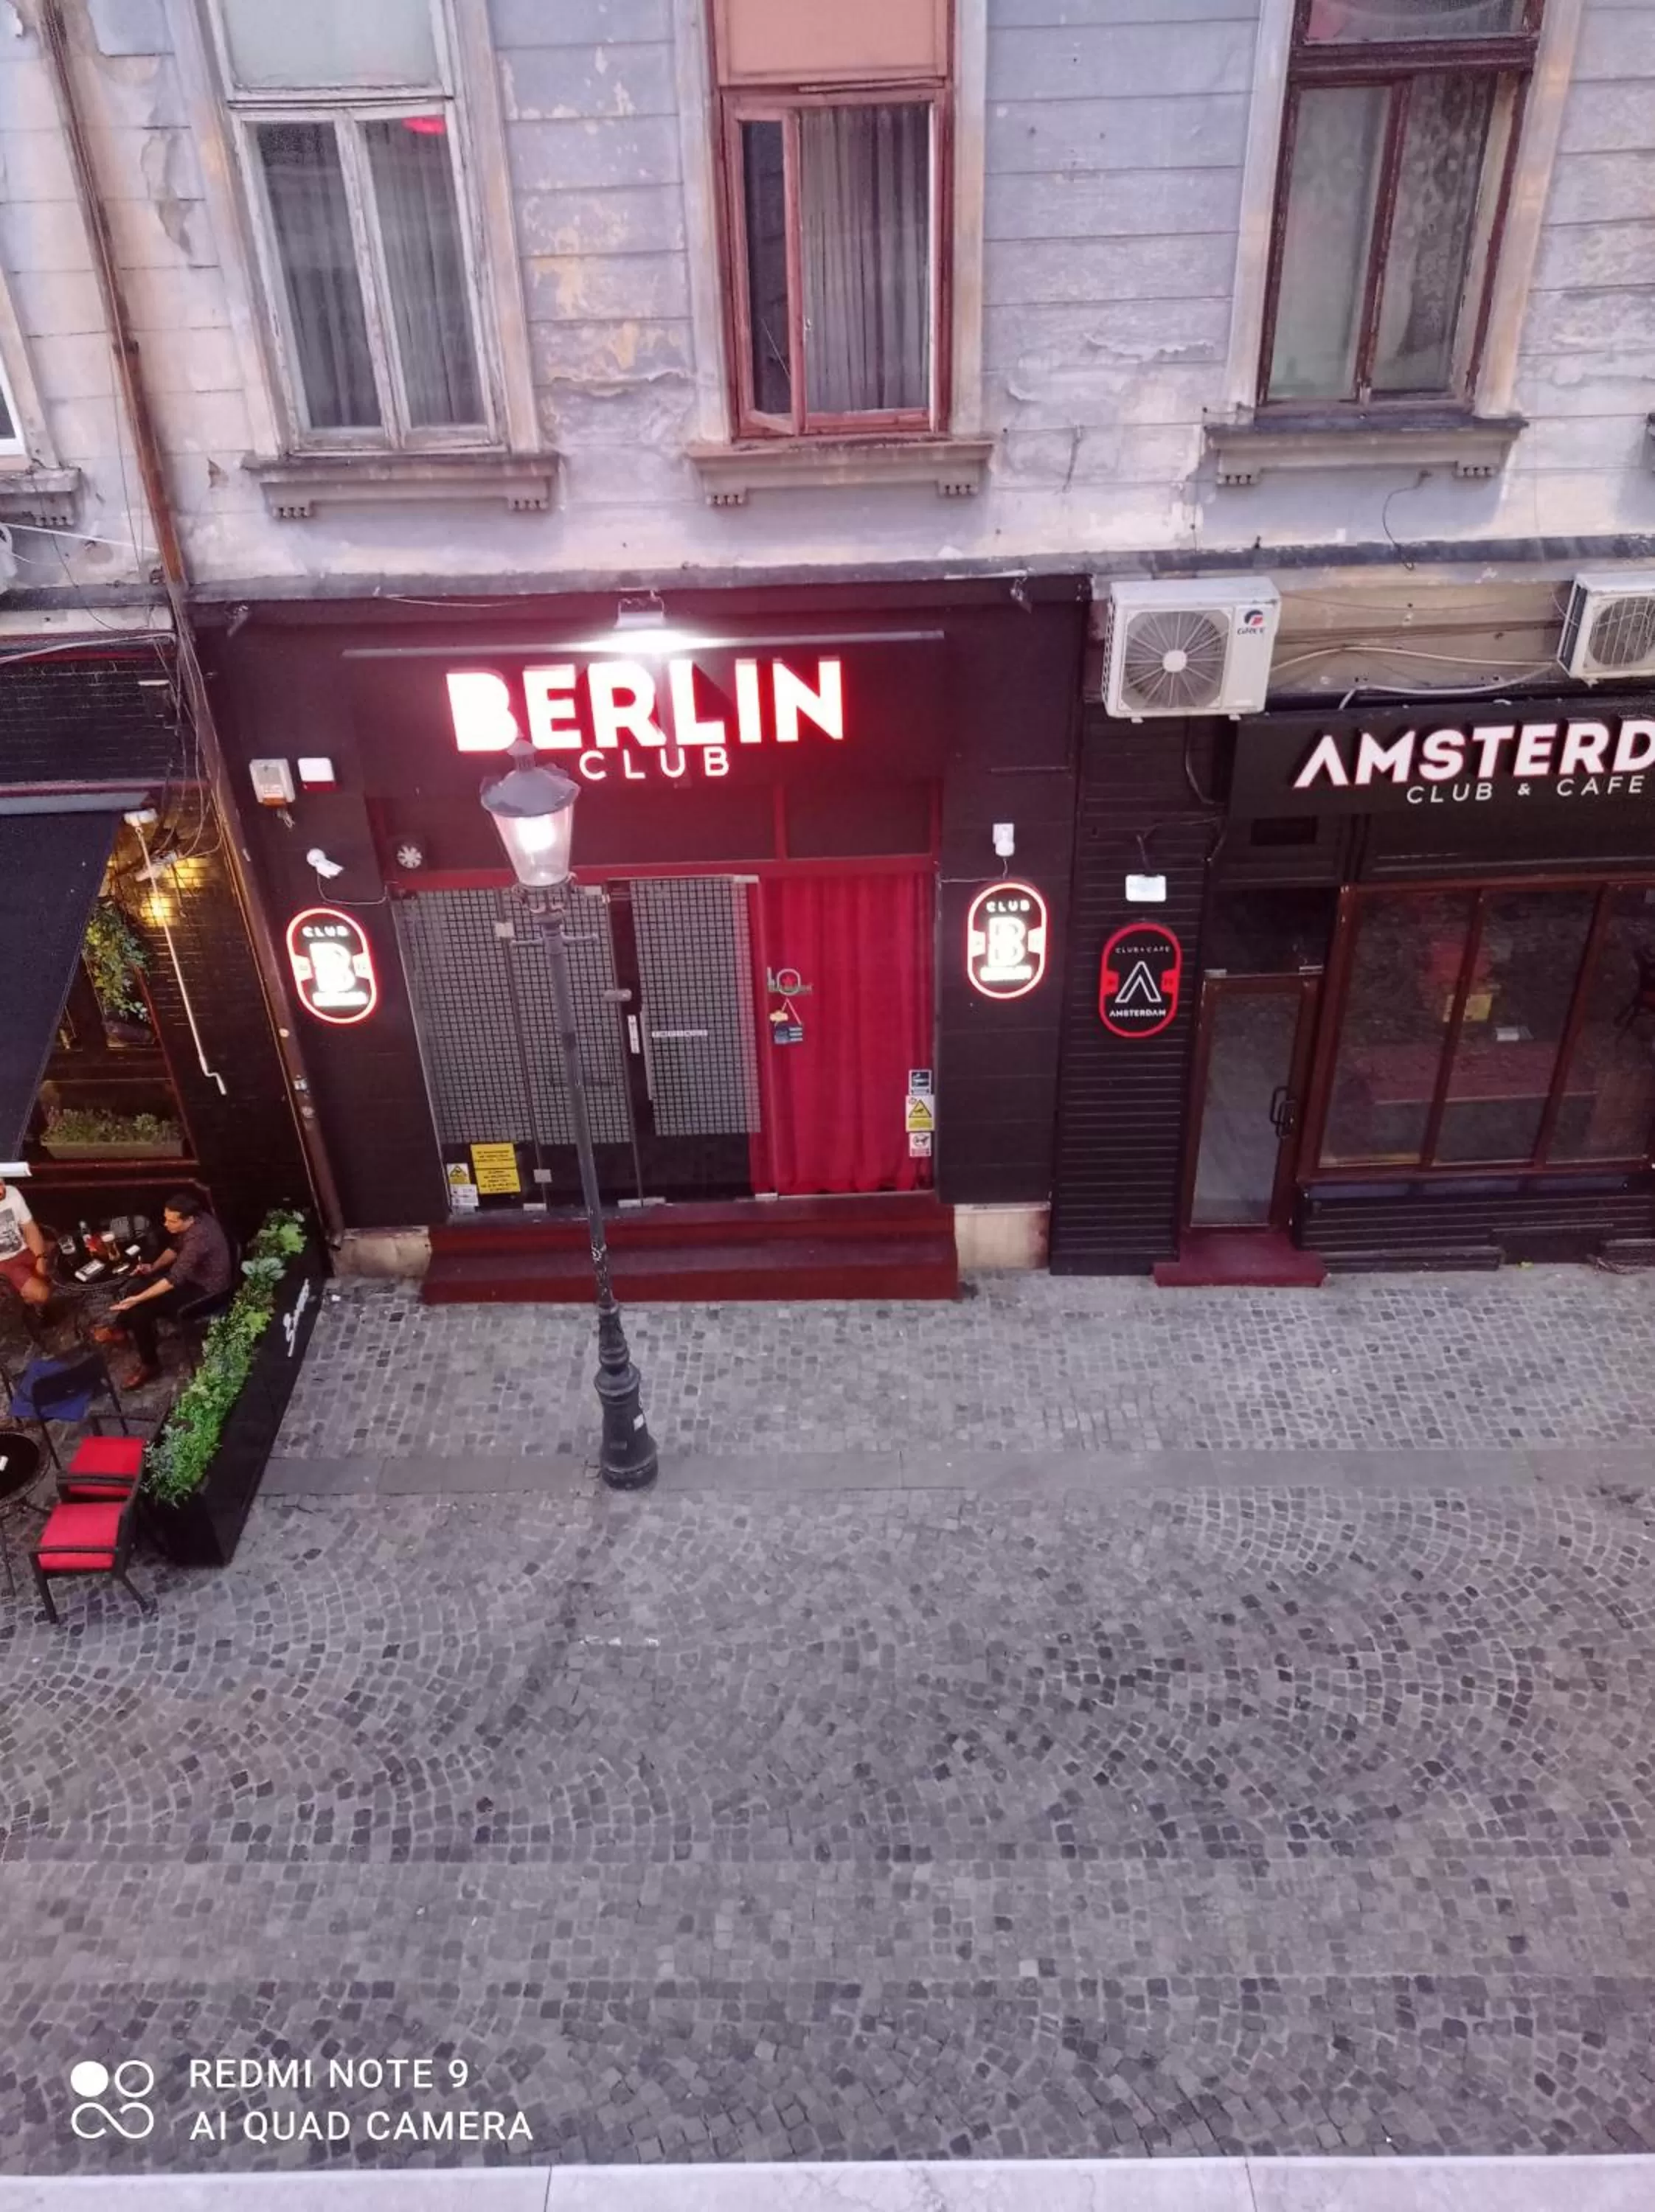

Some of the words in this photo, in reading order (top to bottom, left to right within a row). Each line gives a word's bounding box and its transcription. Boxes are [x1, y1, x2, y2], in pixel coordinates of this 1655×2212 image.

[446, 658, 844, 751] BERLIN
[578, 745, 729, 780] CLUB
[1294, 720, 1655, 787] AMSTERD
[1406, 782, 1493, 804] CLUB
[1517, 782, 1531, 796] &
[1556, 775, 1645, 797] CAFE
[985, 899, 1031, 913] CLUB
[302, 925, 350, 938] CLUB
[988, 917, 1026, 967] B
[1108, 1009, 1167, 1018] AMSTERDAM
